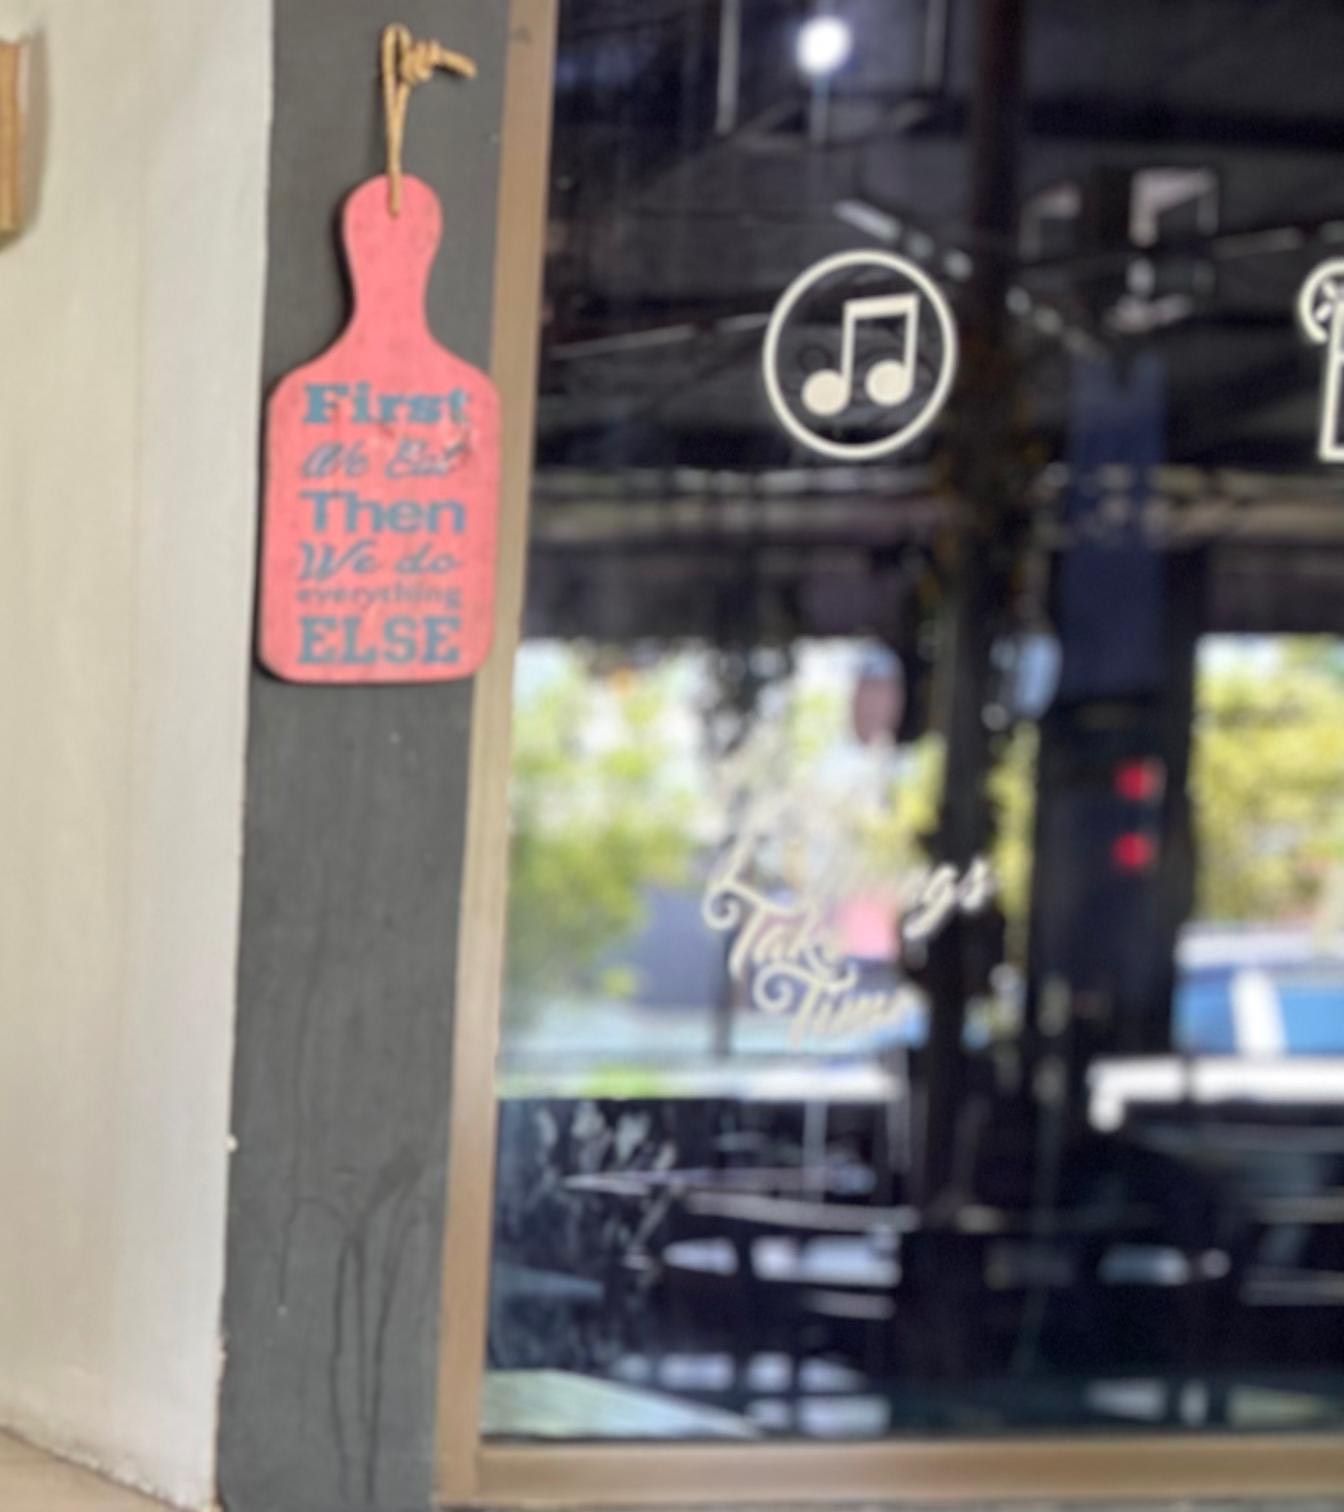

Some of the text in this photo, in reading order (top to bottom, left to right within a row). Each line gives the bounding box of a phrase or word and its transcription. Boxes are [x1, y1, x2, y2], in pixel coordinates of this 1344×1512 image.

[304, 382, 472, 426] First
[298, 489, 467, 534] Then
[298, 537, 462, 581] We do
[297, 581, 461, 611] everything
[297, 615, 461, 665] ELSE
